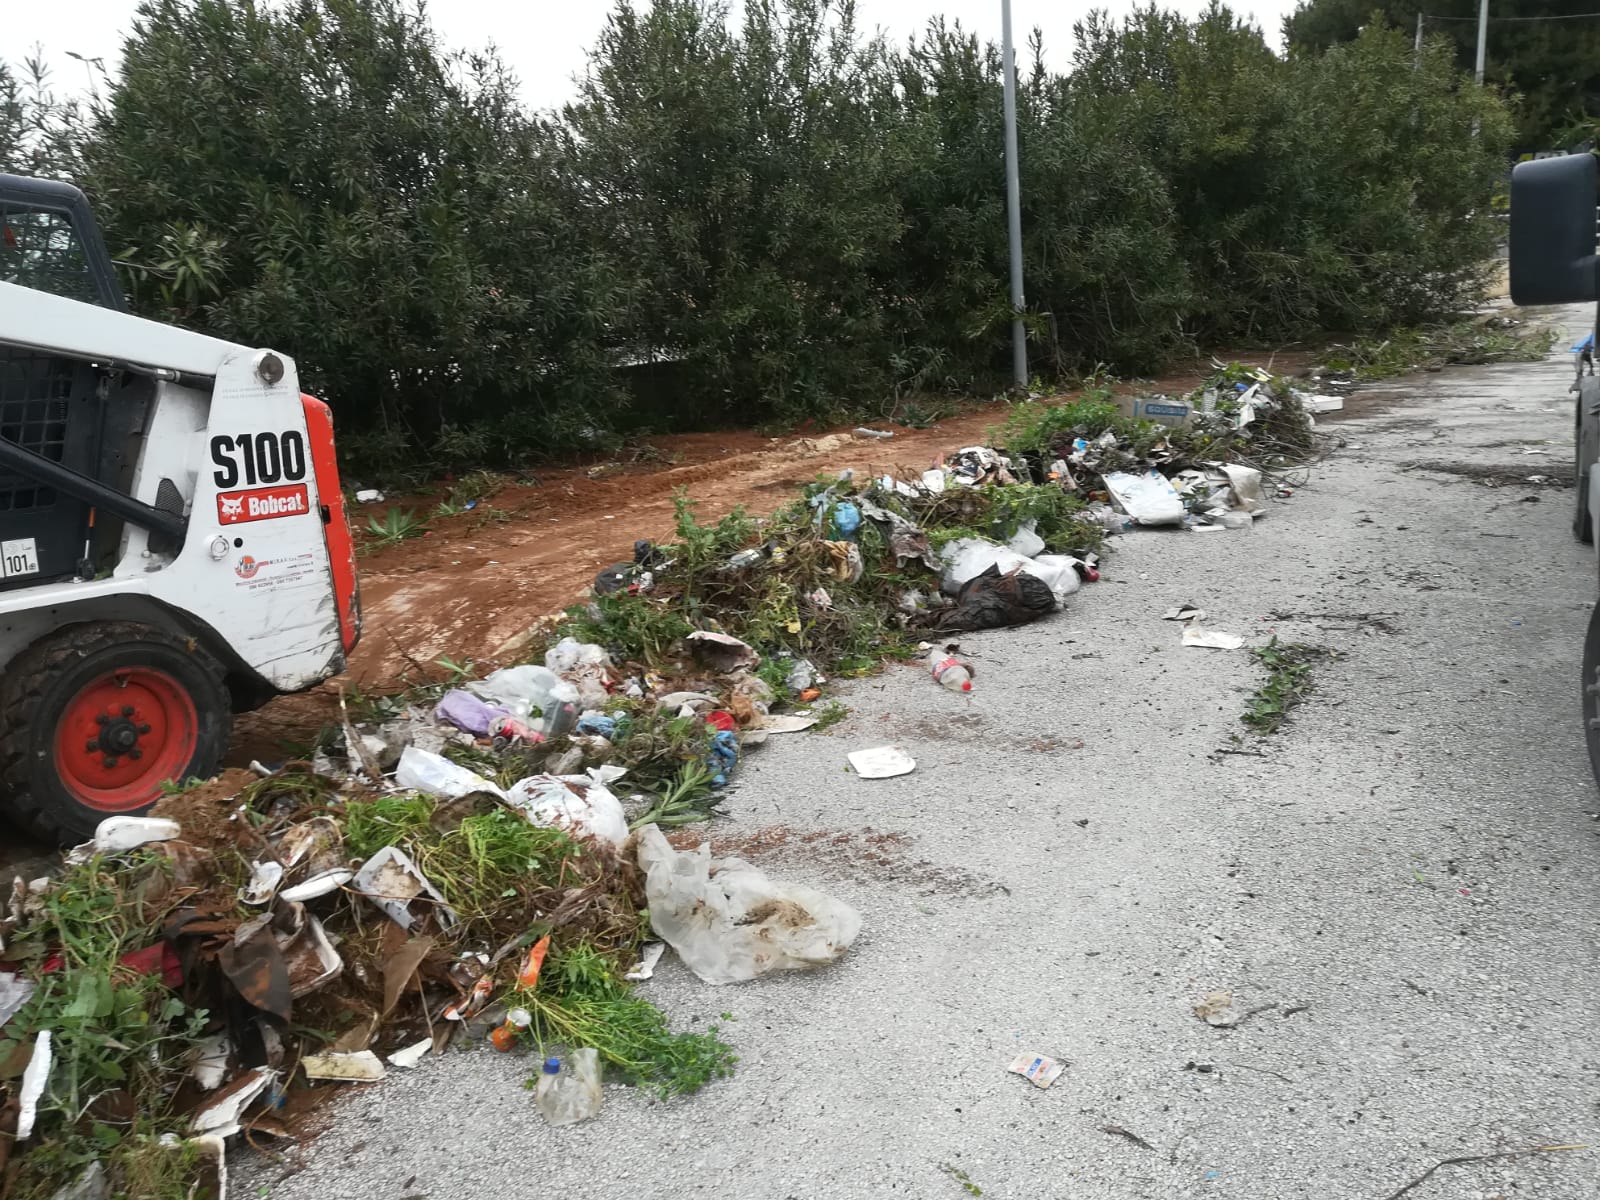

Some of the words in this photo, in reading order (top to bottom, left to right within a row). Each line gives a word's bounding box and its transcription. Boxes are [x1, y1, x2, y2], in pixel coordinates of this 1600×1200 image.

[210, 430, 306, 489] S100
[248, 493, 304, 517] Bobcat
[6, 554, 28, 573] 101
